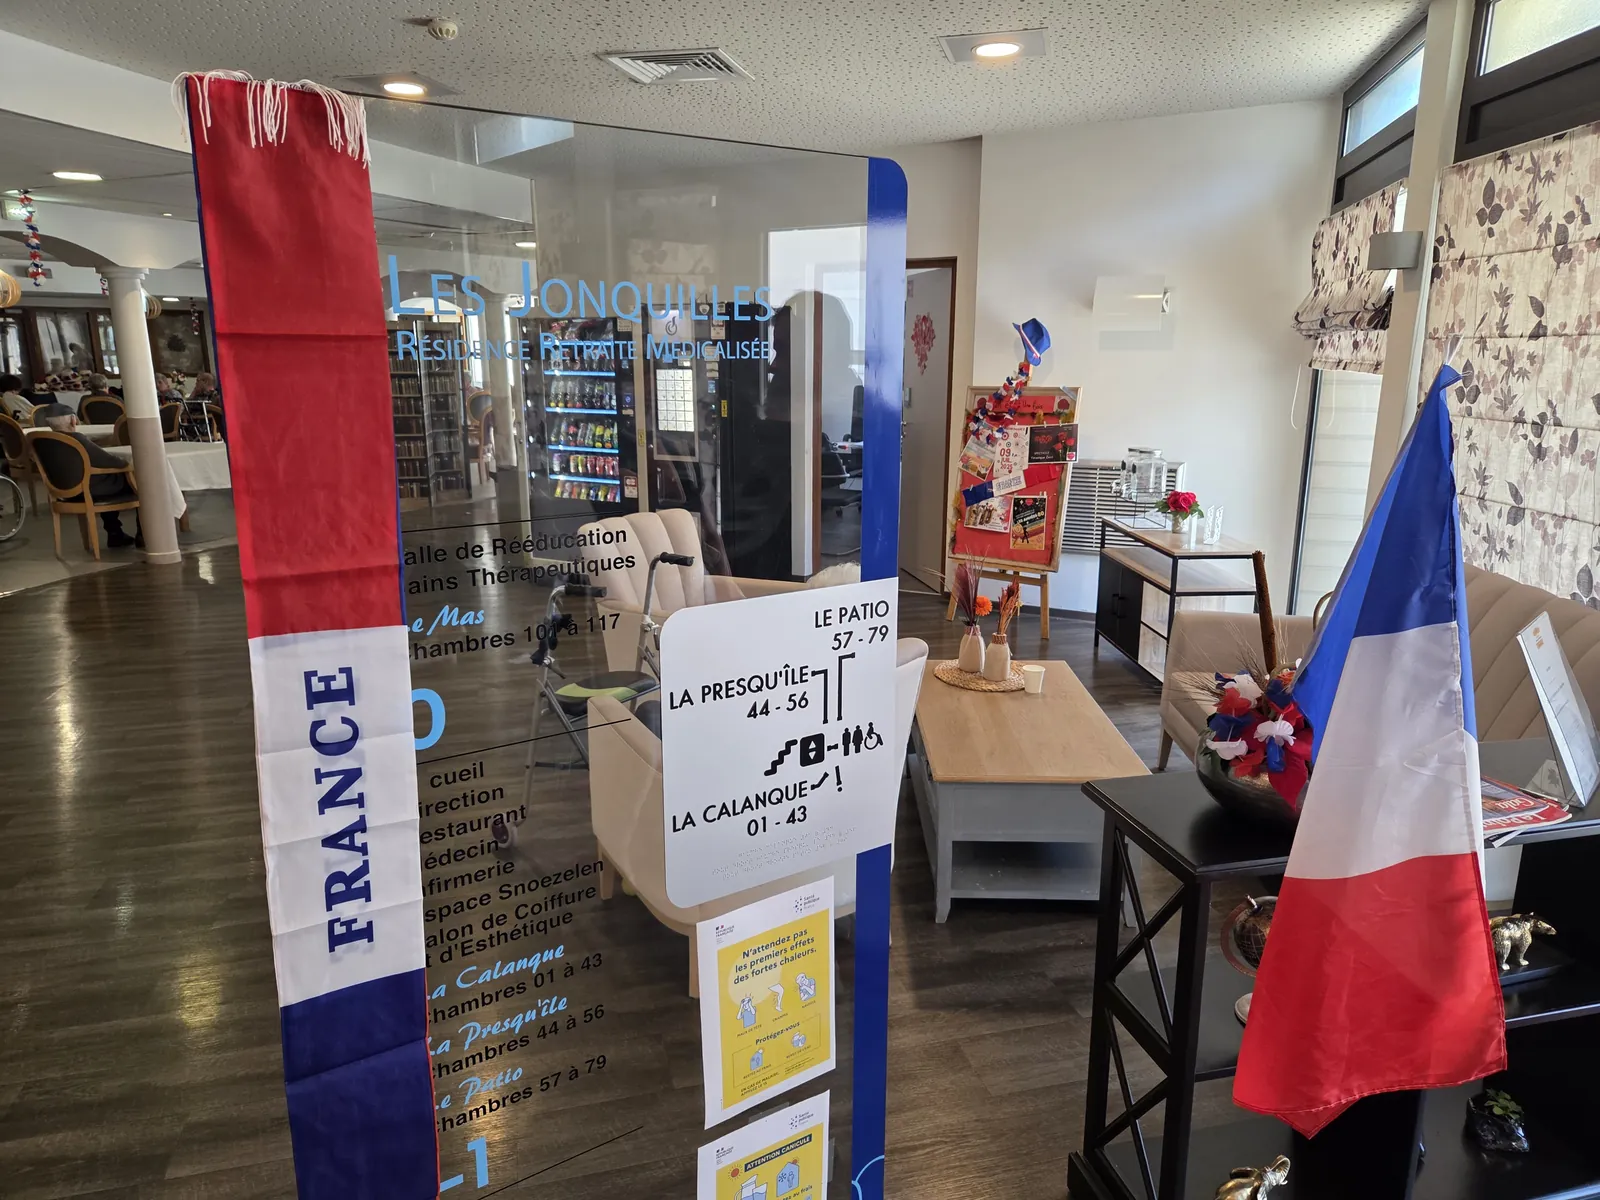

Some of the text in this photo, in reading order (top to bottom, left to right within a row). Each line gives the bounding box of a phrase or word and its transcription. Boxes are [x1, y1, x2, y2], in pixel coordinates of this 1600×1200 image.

[388, 254, 773, 324] LES JONQUILLES
[396, 329, 531, 361] RÉSIDENCE
[539, 332, 638, 360] RETRAITE
[1000, 448, 1011, 457] 09
[404, 528, 627, 566] alle de Rééducation
[408, 554, 636, 595] ains Thérapeutiques
[408, 605, 485, 636] e Mas
[815, 600, 890, 628] LE PATIO
[409, 630, 515, 661] hambres
[567, 619, 578, 636] à
[586, 613, 621, 633] 117
[832, 631, 854, 650] 57
[868, 625, 889, 645] 79
[670, 663, 809, 710] LA PRESQU'ÎLE
[747, 699, 770, 719] 44
[786, 691, 809, 712] 56
[304, 666, 374, 953] FRANCE
[419, 786, 504, 818] irection
[672, 780, 809, 833] LA CALANQUE
[747, 815, 767, 837] 01
[786, 805, 808, 826] 43
[1495, 797, 1535, 810] Gala
[420, 804, 527, 844] estaurant
[423, 838, 499, 870] édecin
[422, 861, 515, 897] firmerie
[425, 860, 604, 923] space Snoezelen
[426, 886, 597, 948] alon de Coiffure
[440, 911, 573, 964] d'Esthétique
[735, 936, 815, 973] les premiers effets
[742, 928, 808, 959] N'attendez pas
[427, 945, 564, 999] a Calanque
[733, 947, 817, 985] des fortes chaleurs.
[429, 953, 602, 1025] hambres 01 à 43
[458, 996, 568, 1050] Presqu'île
[537, 1026, 559, 1045] 44
[566, 1015, 577, 1030] à
[583, 1004, 605, 1024] 56
[459, 1067, 523, 1105] Patio
[540, 1072, 562, 1092] 57
[568, 1066, 579, 1081] à
[585, 1055, 607, 1074] 79
[746, 1136, 810, 1170] ATTENTION CANICULE
